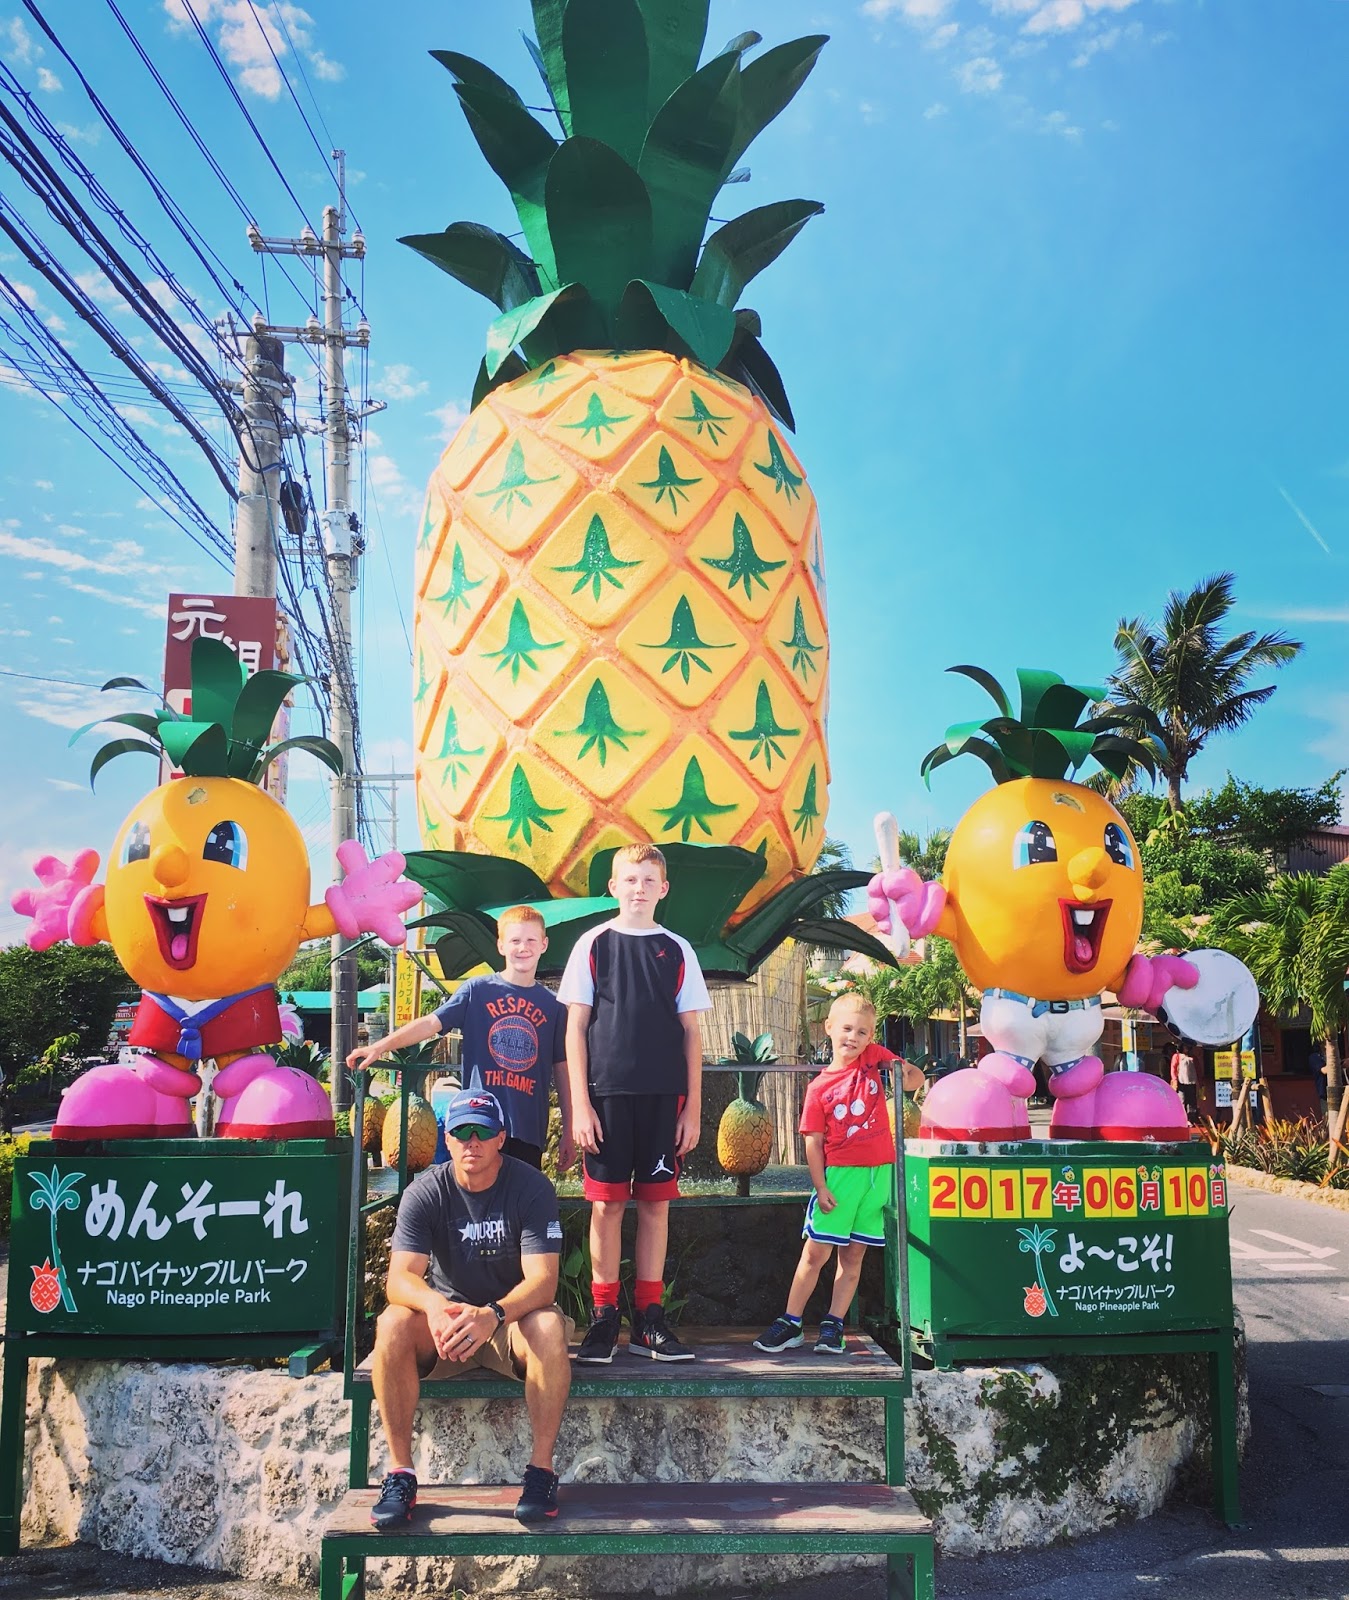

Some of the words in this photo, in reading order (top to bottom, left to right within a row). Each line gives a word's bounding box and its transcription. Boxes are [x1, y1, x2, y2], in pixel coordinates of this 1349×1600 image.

[486, 996, 547, 1027] RESPECT
[485, 1070, 506, 1086] THE
[506, 1071, 537, 1096] GAME
[85, 1179, 309, 1241] めんそーれ
[76, 1258, 308, 1287] ナゴパイナップルパーク
[106, 1290, 146, 1308] Nago
[150, 1289, 230, 1308] Pineapple
[235, 1288, 271, 1303] Park
[1075, 1302, 1098, 1312] Nago
[1099, 1302, 1140, 1312] Pineapple
[1142, 1301, 1160, 1310] Park
